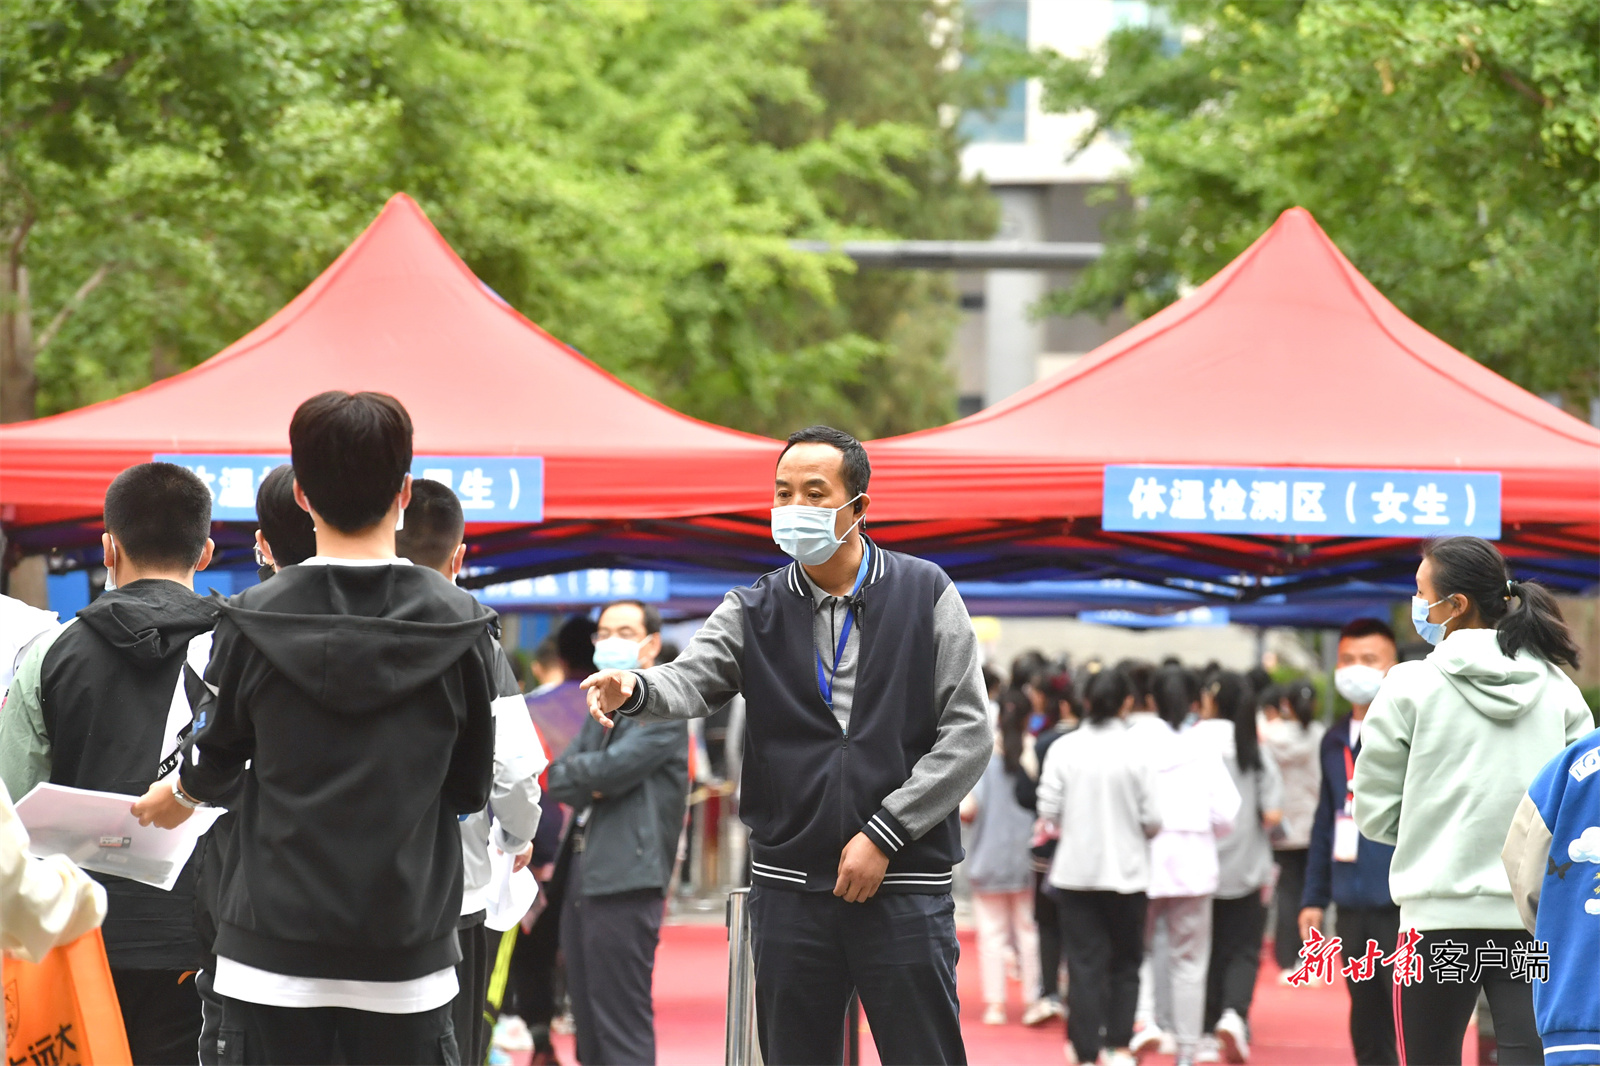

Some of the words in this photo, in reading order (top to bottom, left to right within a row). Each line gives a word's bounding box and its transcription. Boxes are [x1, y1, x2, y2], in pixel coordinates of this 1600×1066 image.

[1128, 477, 1477, 527] 体温检测区（女生）
